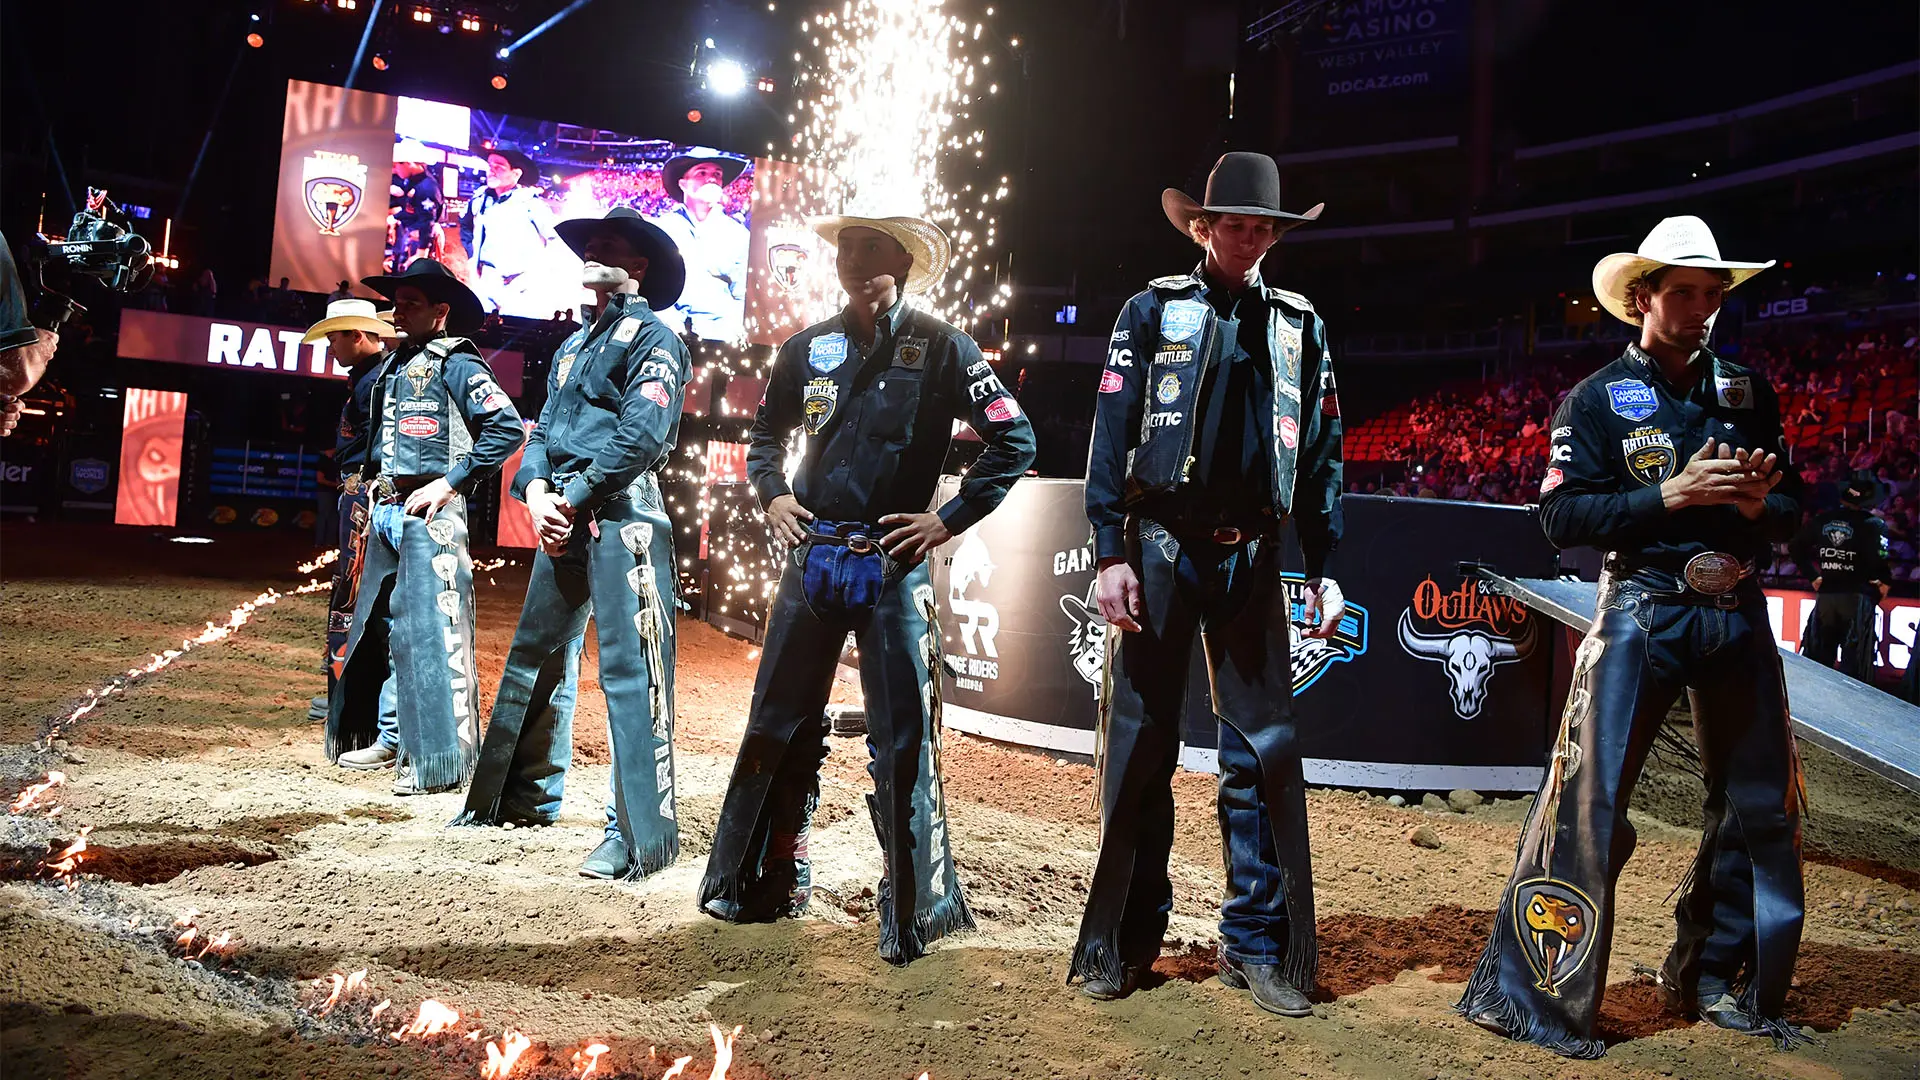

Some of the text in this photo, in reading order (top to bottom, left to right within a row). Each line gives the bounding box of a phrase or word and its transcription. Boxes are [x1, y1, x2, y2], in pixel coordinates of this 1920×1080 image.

[1319, 40, 1442, 69] WEST VALLEY
[1328, 72, 1429, 95] DDCAZ.com
[62, 244, 93, 254] RONIN
[1759, 298, 1808, 318] JCB
[815, 346, 843, 356] WORLD
[1155, 350, 1193, 365] RATTLERS
[1613, 388, 1650, 396] CAMPING
[1615, 394, 1651, 403] WORLD
[382, 392, 397, 457] ARIAT
[1628, 428, 1662, 438] TEXAS
[1621, 432, 1674, 457] RATTLERS
[78, 471, 105, 480] WORLD
[968, 659, 999, 680] RIDERS
[443, 626, 472, 745] ARIAT
